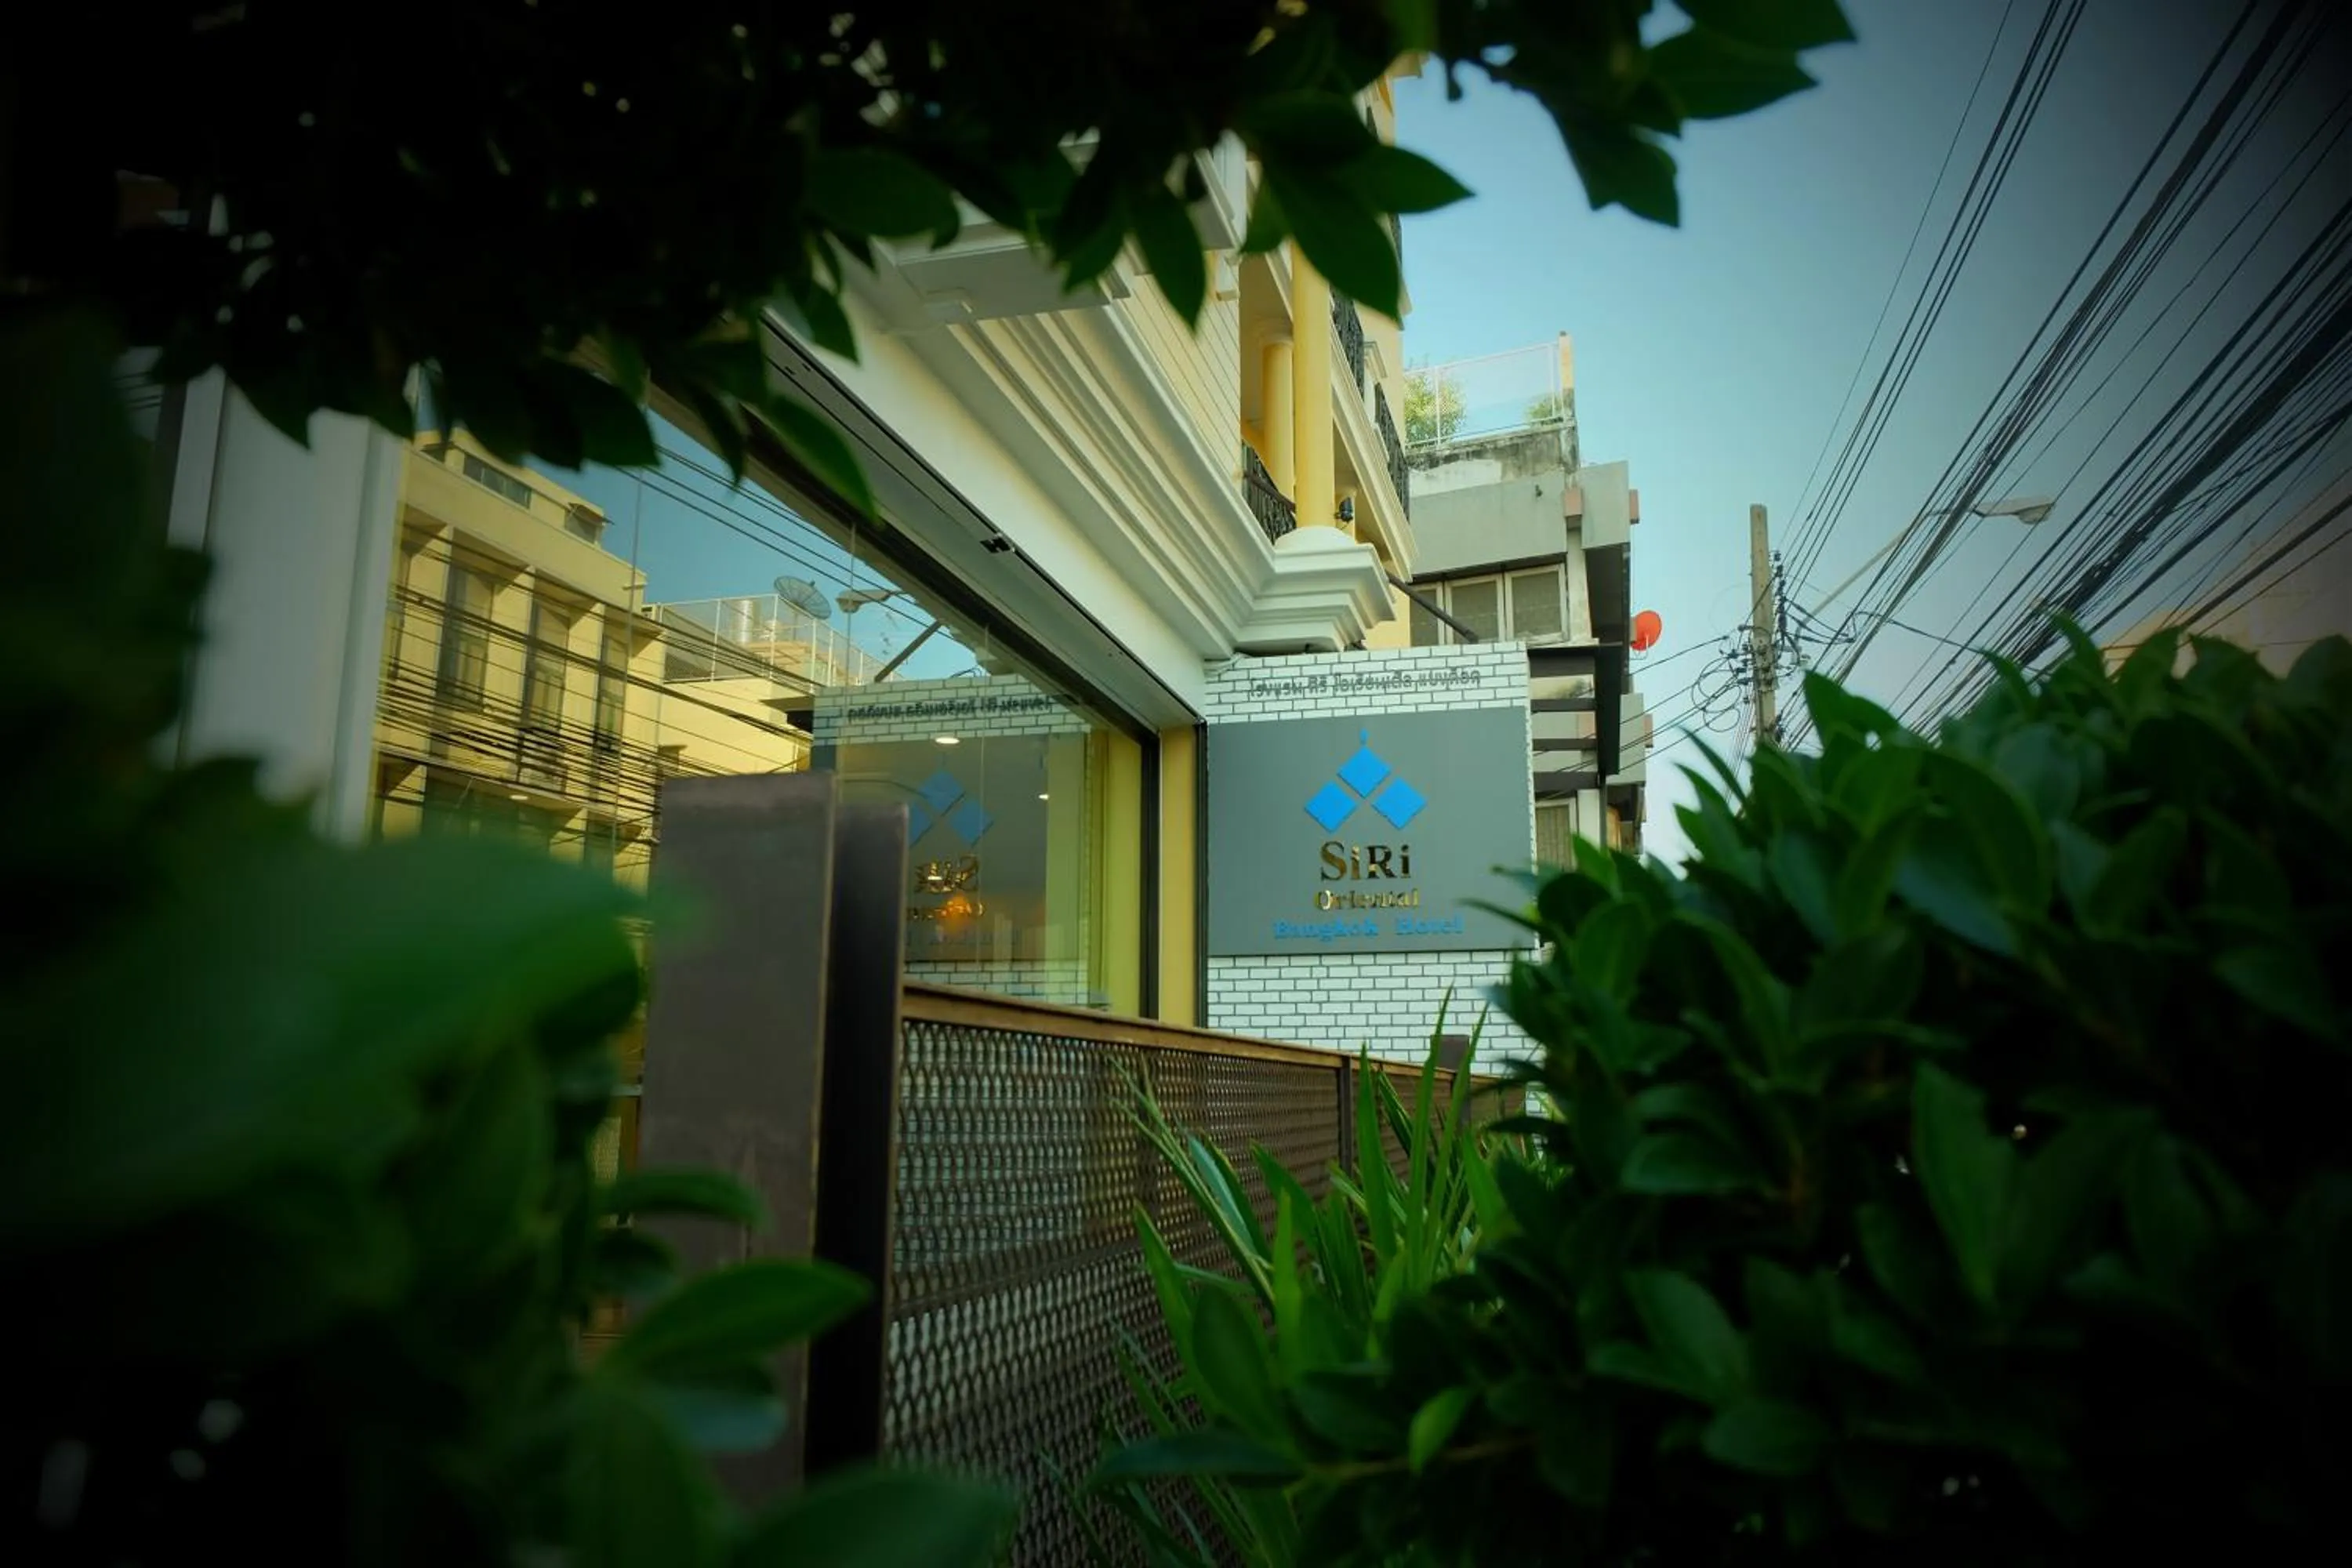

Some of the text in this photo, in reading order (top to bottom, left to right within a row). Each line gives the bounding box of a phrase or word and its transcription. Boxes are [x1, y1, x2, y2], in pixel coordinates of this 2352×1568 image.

[1314, 888, 1419, 910] Oriental
[1274, 914, 1465, 941] Bangkok Hotel
